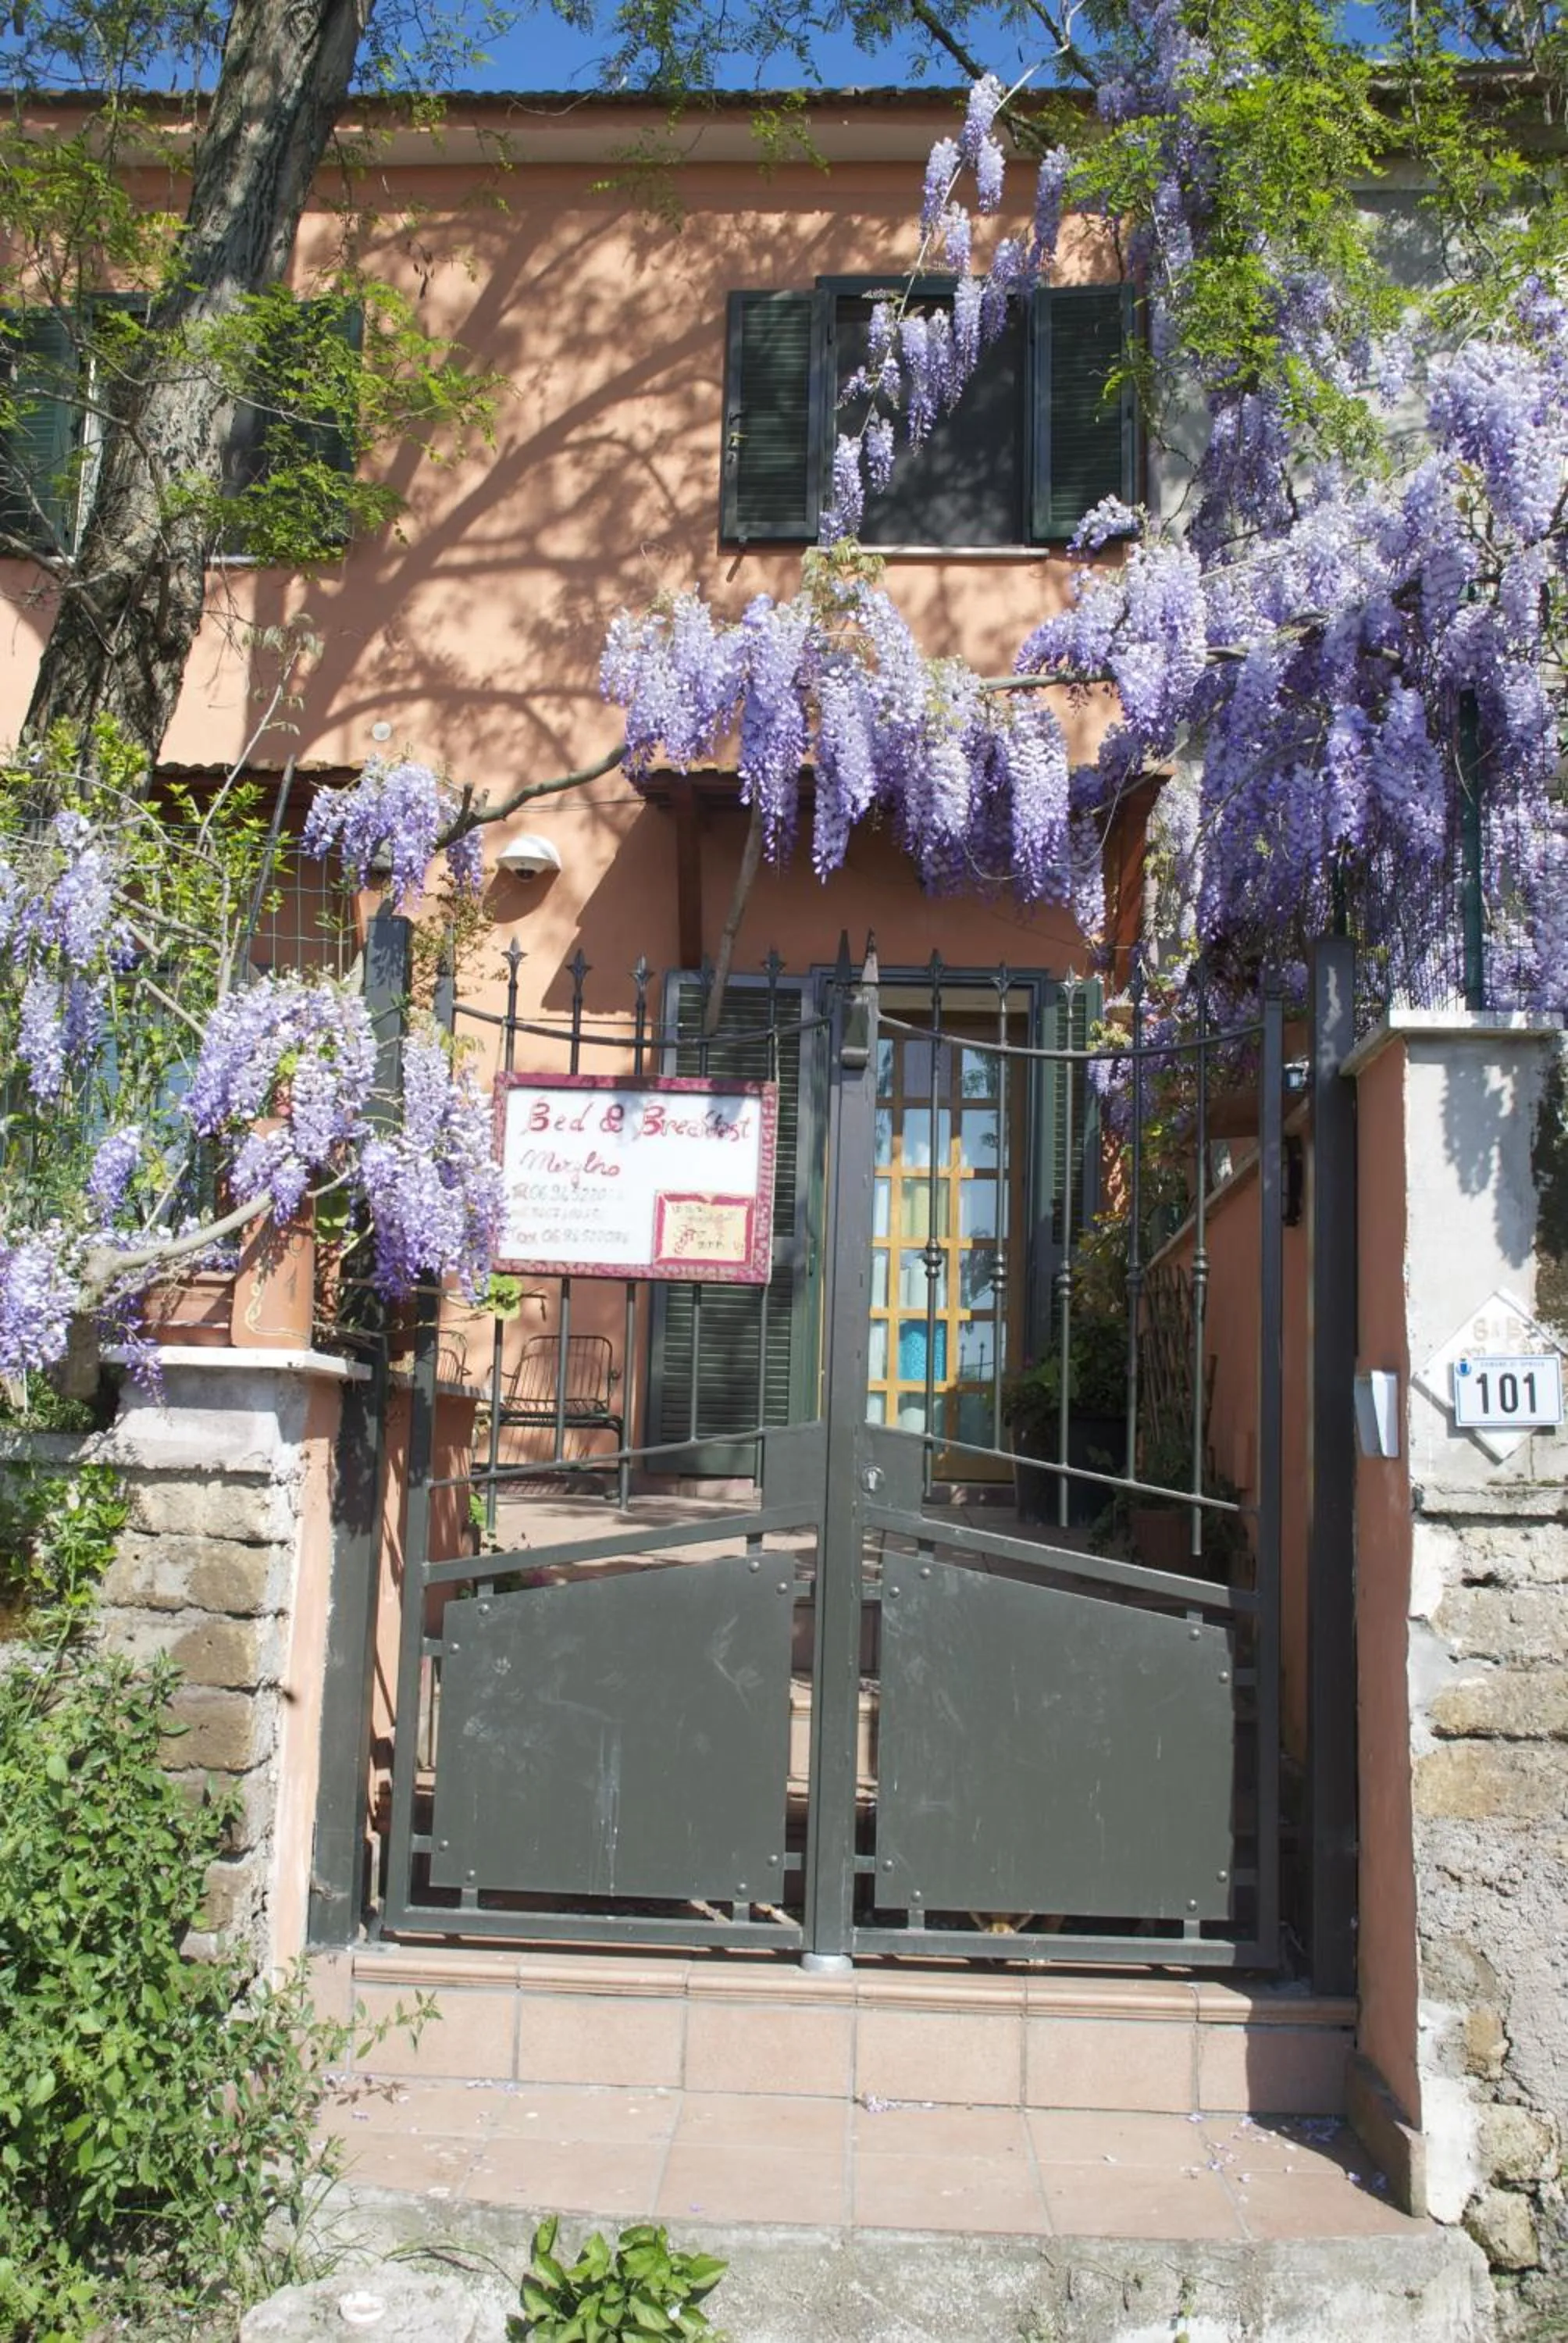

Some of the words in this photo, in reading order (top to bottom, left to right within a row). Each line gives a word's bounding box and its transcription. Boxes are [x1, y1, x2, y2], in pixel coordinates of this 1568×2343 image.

[521, 1097, 594, 1136] Bed
[599, 1103, 624, 1133] &
[1476, 1371, 1536, 1414] 101
